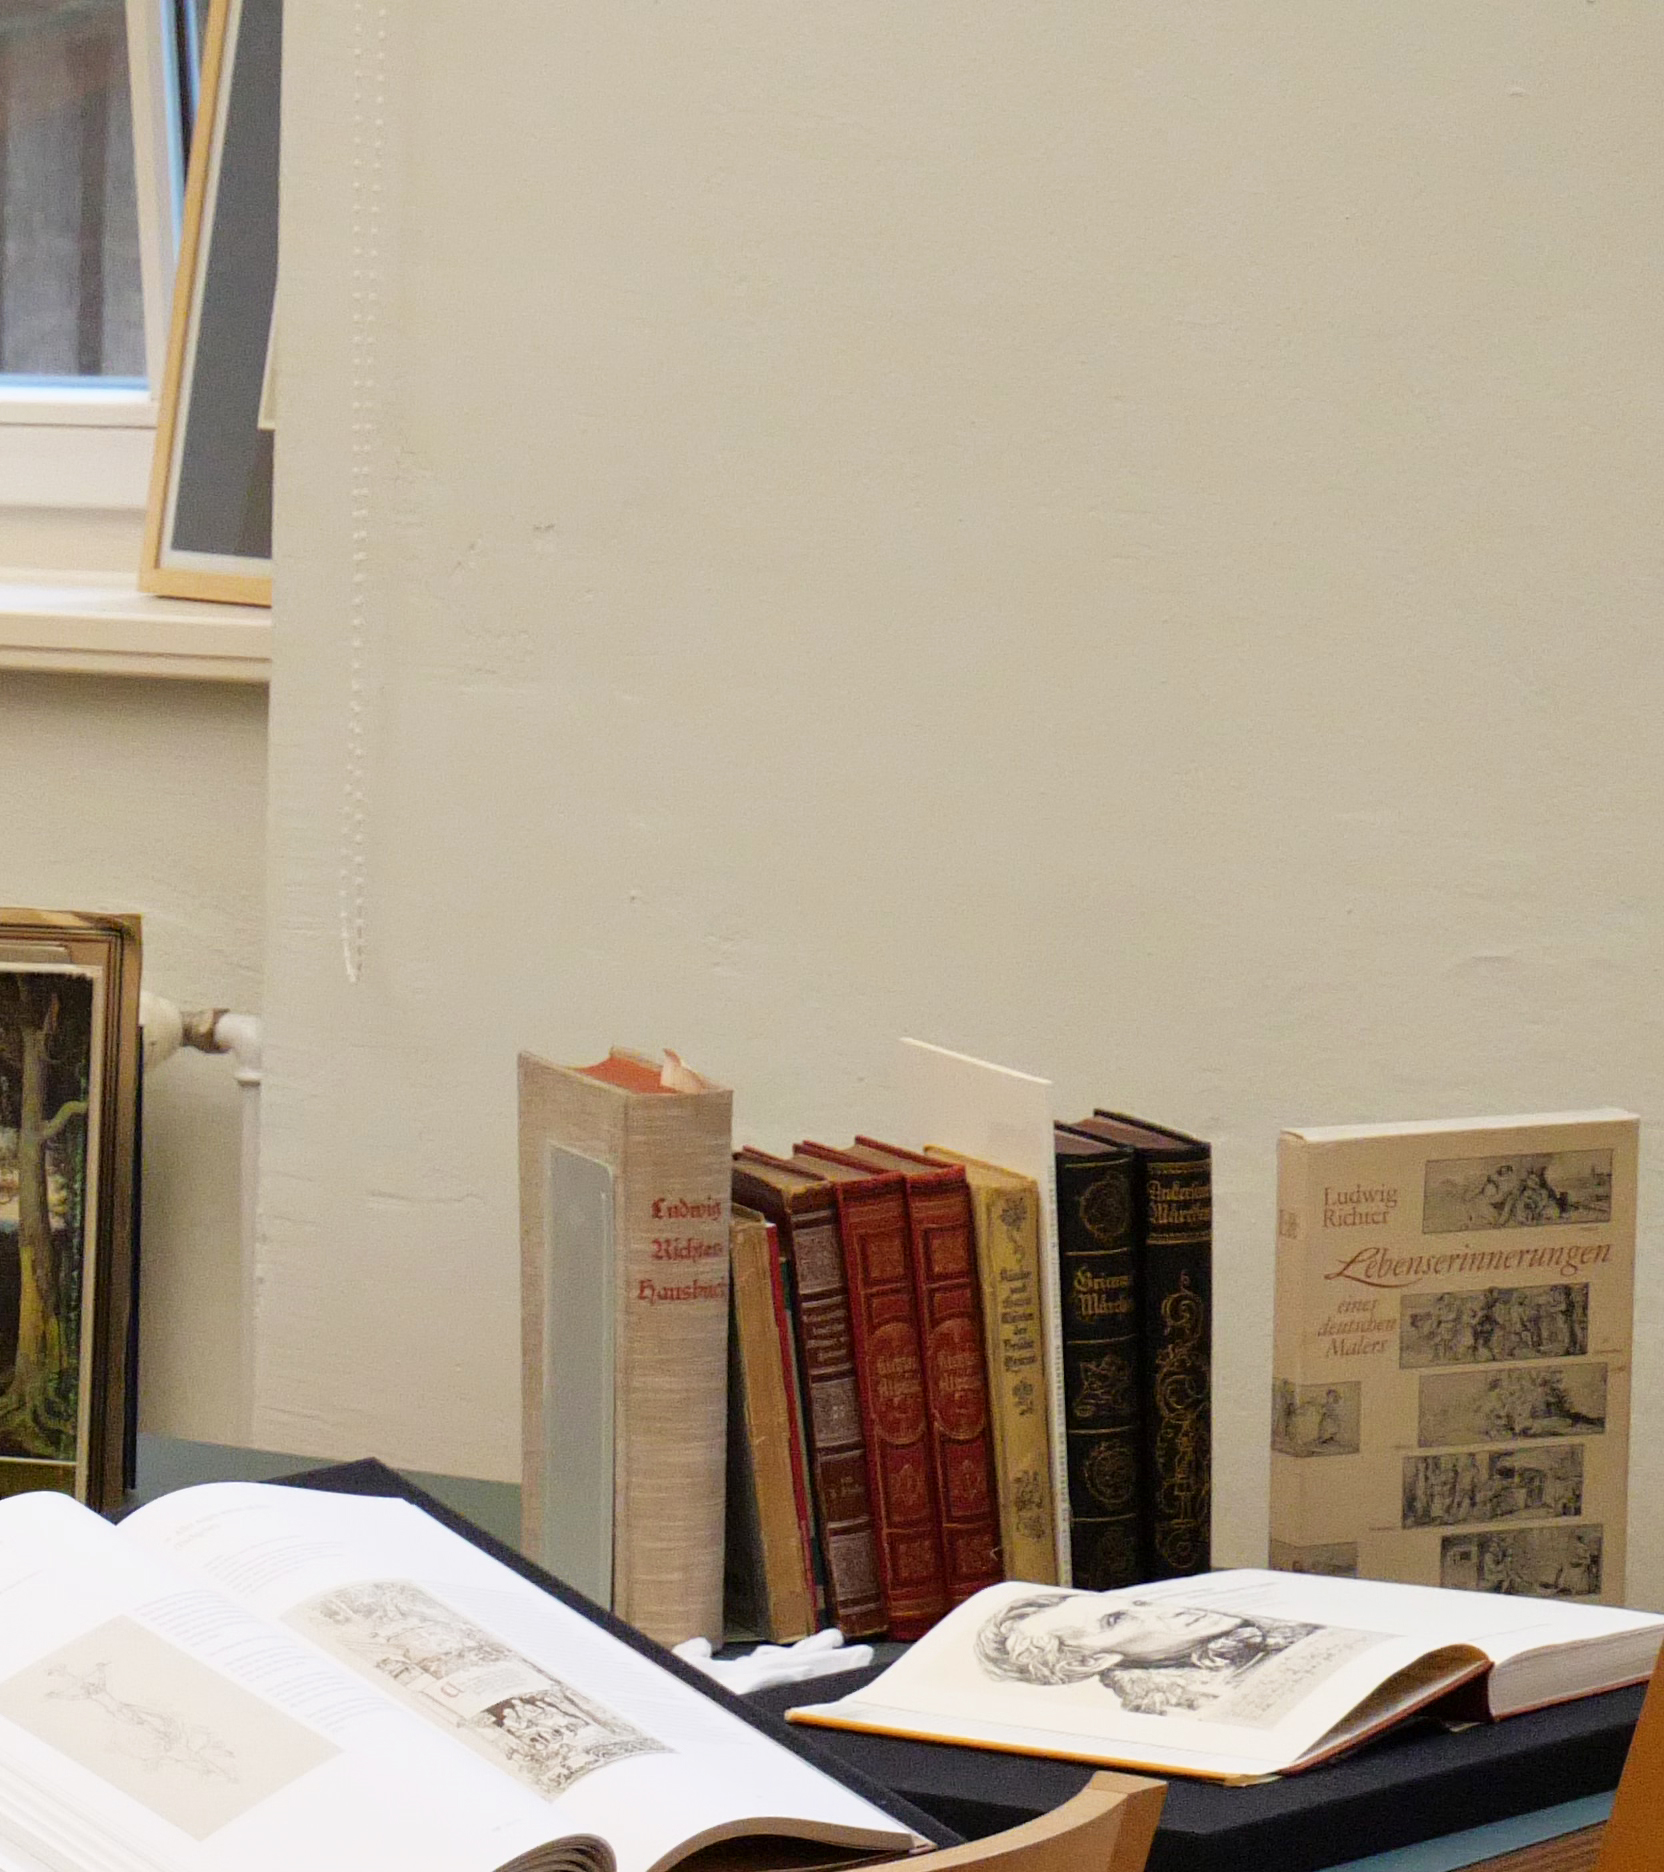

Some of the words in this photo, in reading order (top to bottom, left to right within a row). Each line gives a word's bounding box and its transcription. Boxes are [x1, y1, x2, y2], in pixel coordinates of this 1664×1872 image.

[1323, 1182, 1398, 1208] Ludwig
[651, 1196, 722, 1221] Ludwig
[1322, 1206, 1390, 1229] Richter
[1323, 1243, 1613, 1289] Lebenserinnerungen
